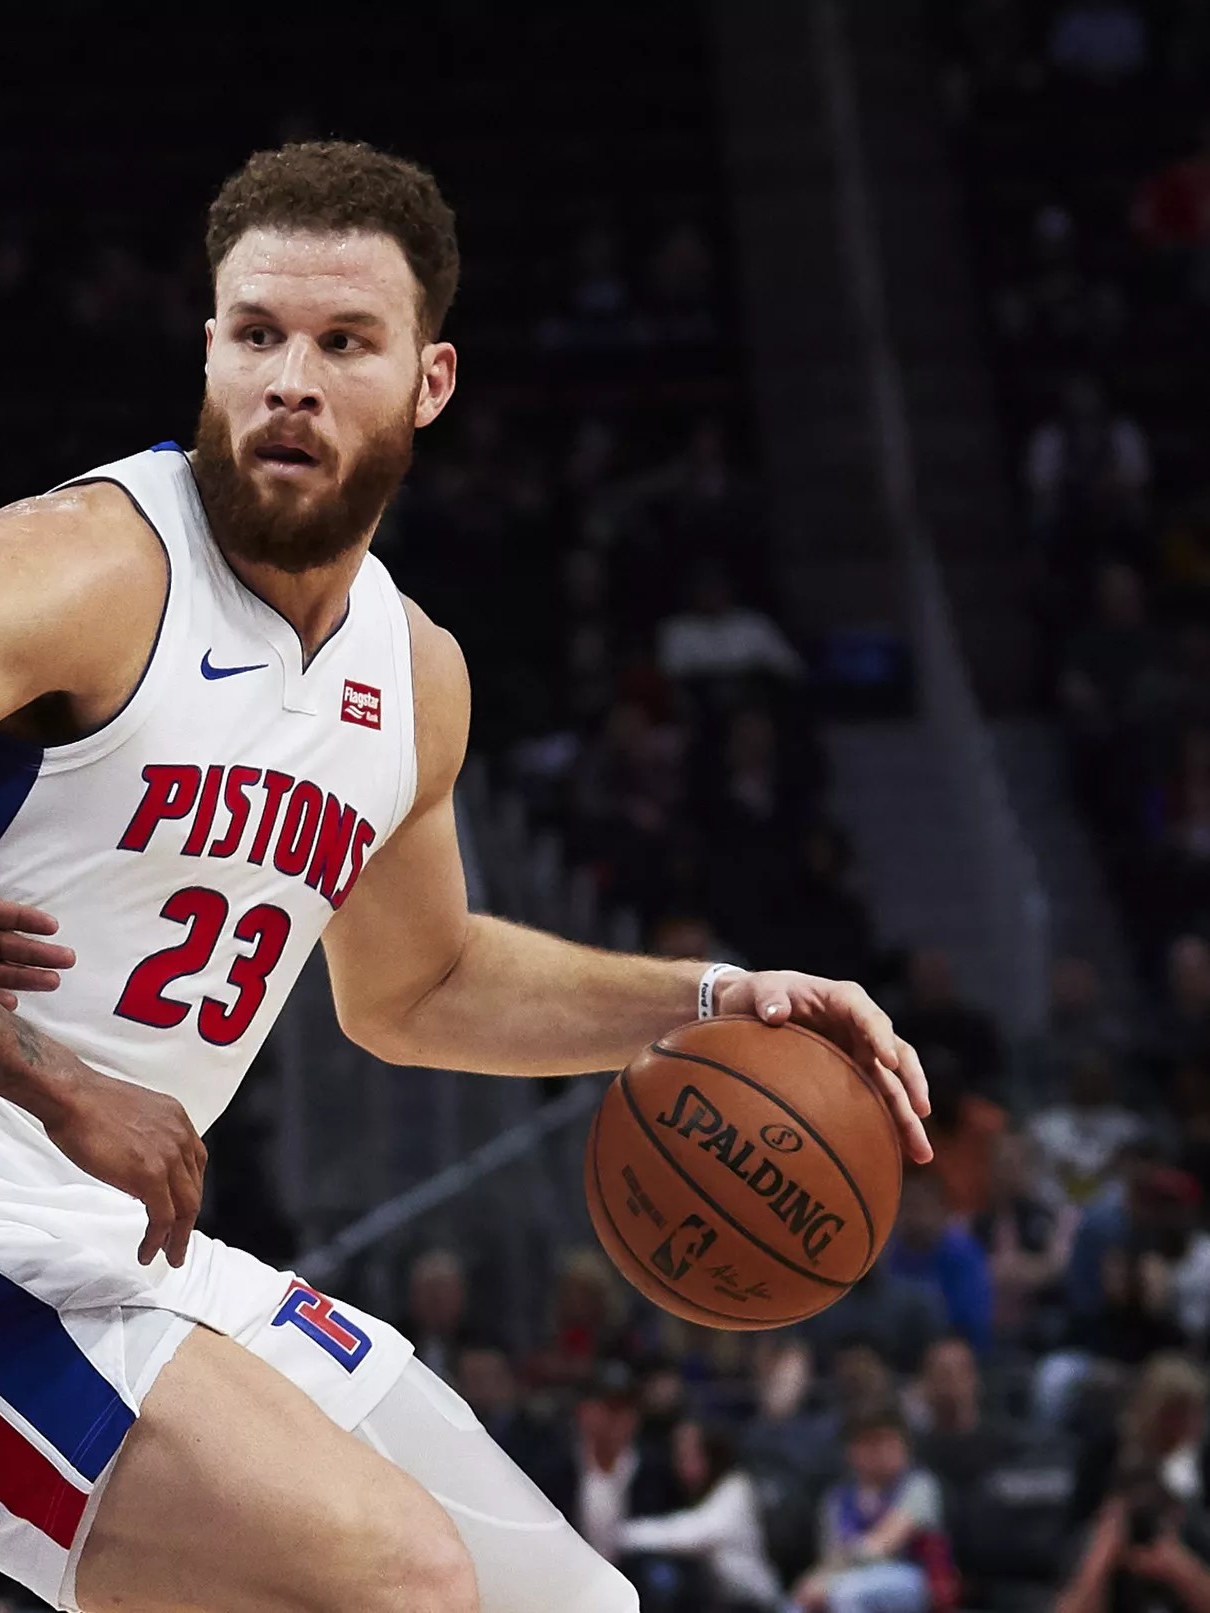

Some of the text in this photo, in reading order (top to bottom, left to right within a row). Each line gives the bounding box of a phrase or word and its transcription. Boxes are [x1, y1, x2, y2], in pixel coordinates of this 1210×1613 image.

[344, 685, 379, 710] Flagstar
[117, 764, 376, 911] PISTONS
[114, 886, 291, 1047] 23
[656, 1085, 846, 1263] SPALDING
